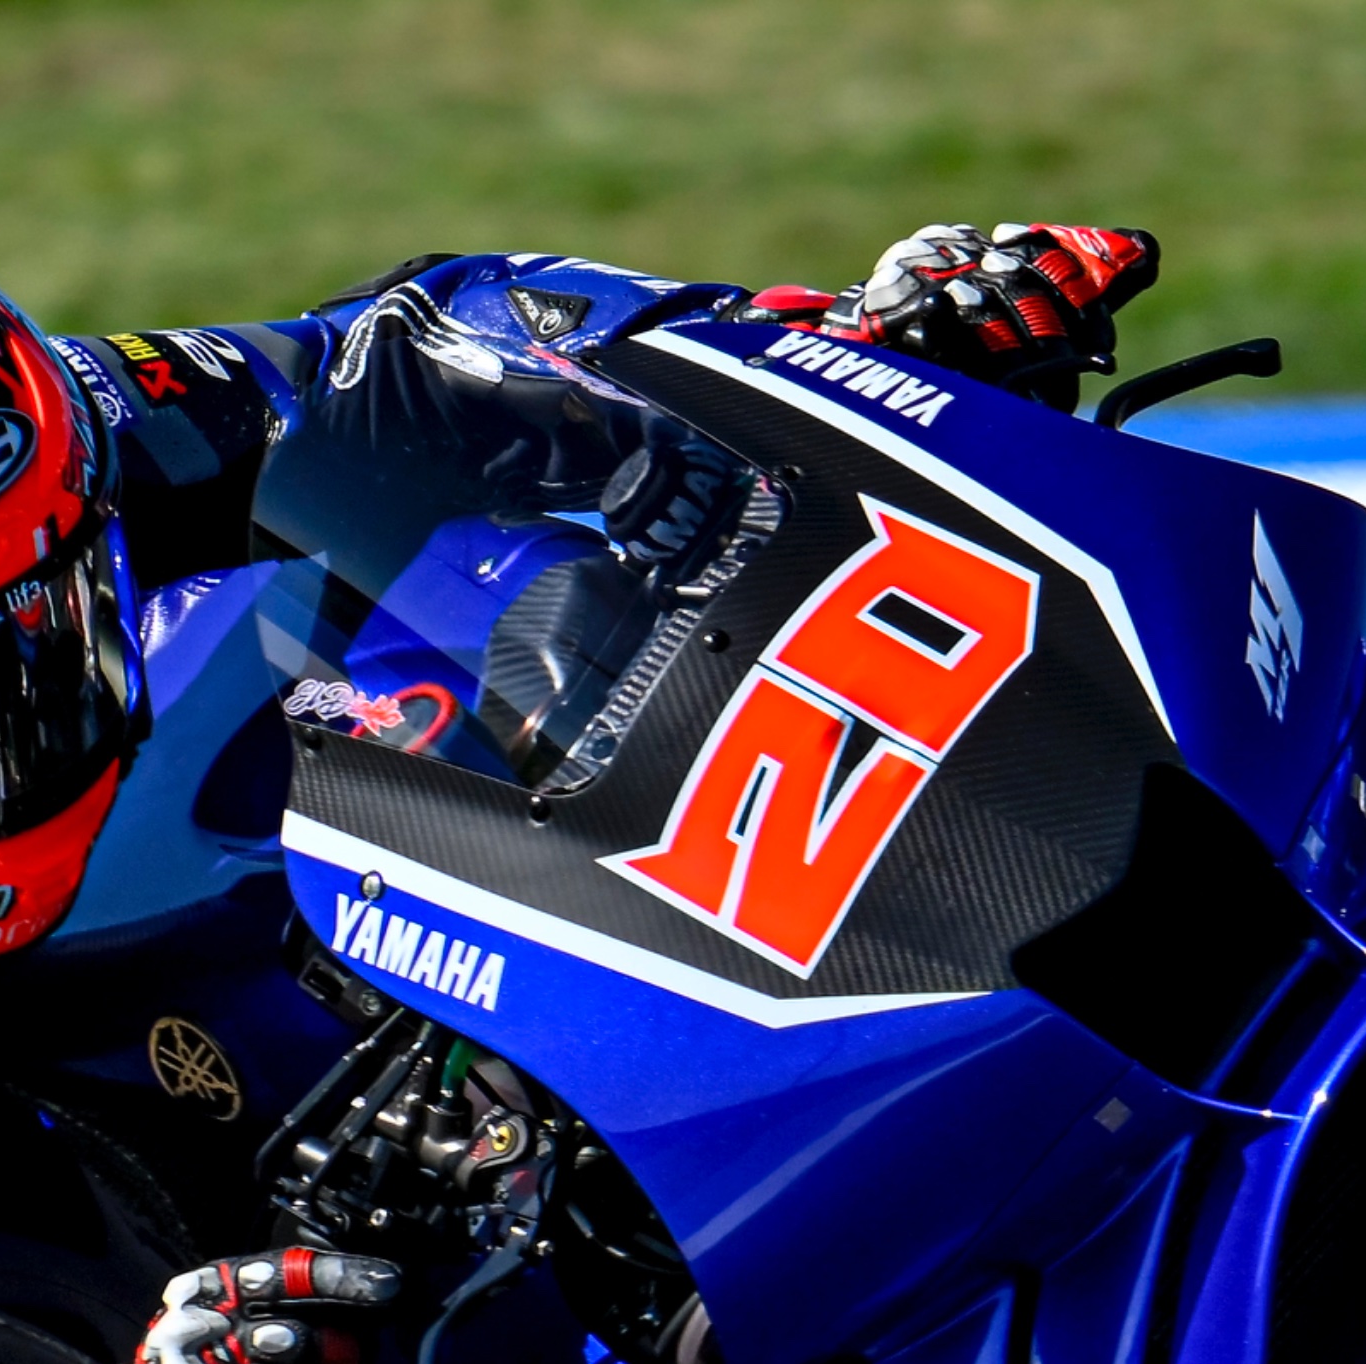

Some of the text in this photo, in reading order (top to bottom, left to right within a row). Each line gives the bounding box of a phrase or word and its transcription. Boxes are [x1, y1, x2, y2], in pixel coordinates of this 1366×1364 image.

[765, 330, 955, 427] YAMAHA
[595, 492, 1040, 980] 20
[332, 893, 506, 1013] YAMAHA
